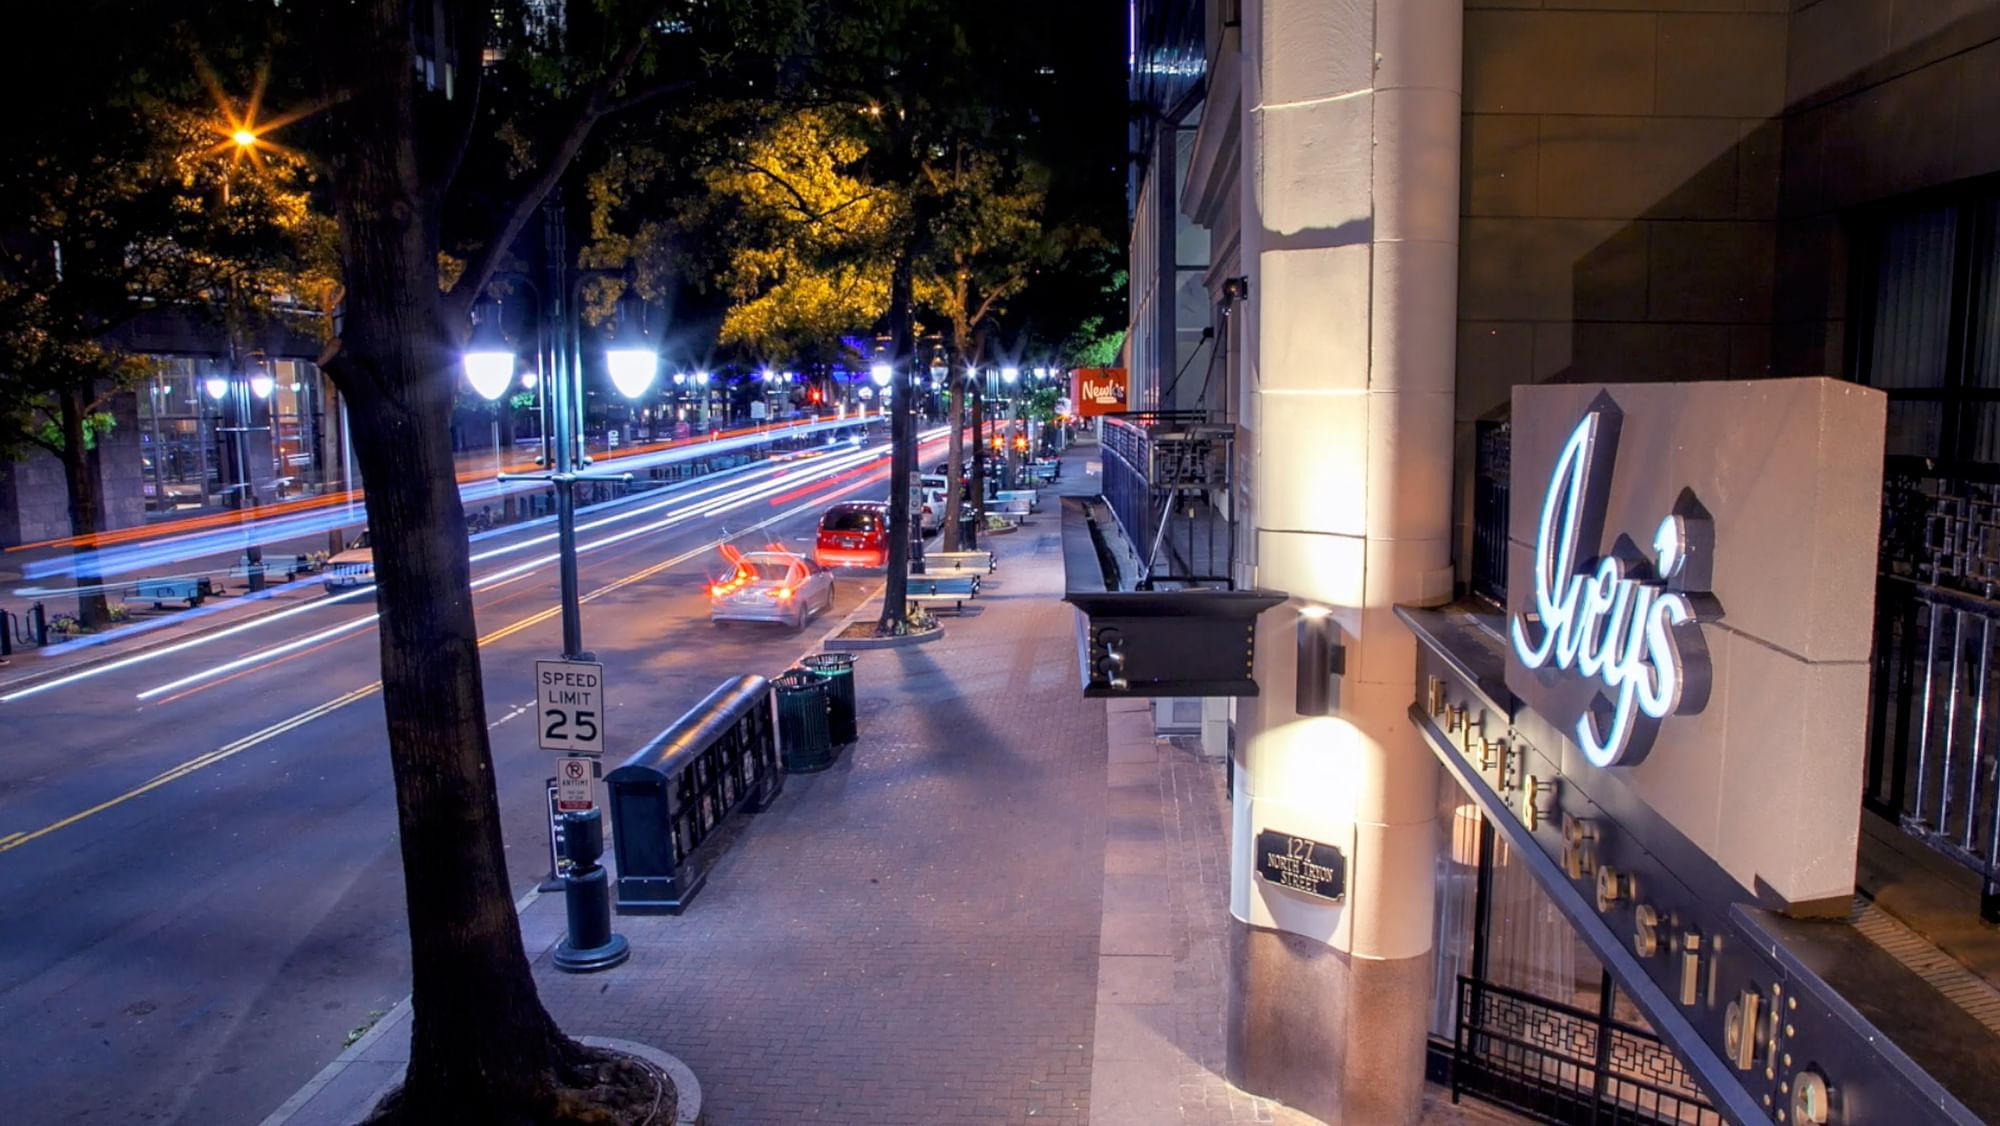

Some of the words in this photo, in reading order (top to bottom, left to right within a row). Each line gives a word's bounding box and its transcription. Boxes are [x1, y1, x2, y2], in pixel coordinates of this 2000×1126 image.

[1082, 379, 1125, 401] Newk's
[1511, 411, 1696, 768] Ivey's
[542, 671, 598, 688] SPEED
[548, 690, 592, 706] LIMIT
[545, 709, 598, 742] 25
[1428, 674, 1506, 792] Hotel
[1523, 773, 1538, 832] &
[1287, 837, 1315, 863] 127
[1267, 853, 1300, 874] NORTH
[1303, 861, 1334, 882] TRYON
[1280, 872, 1318, 893] STREET
